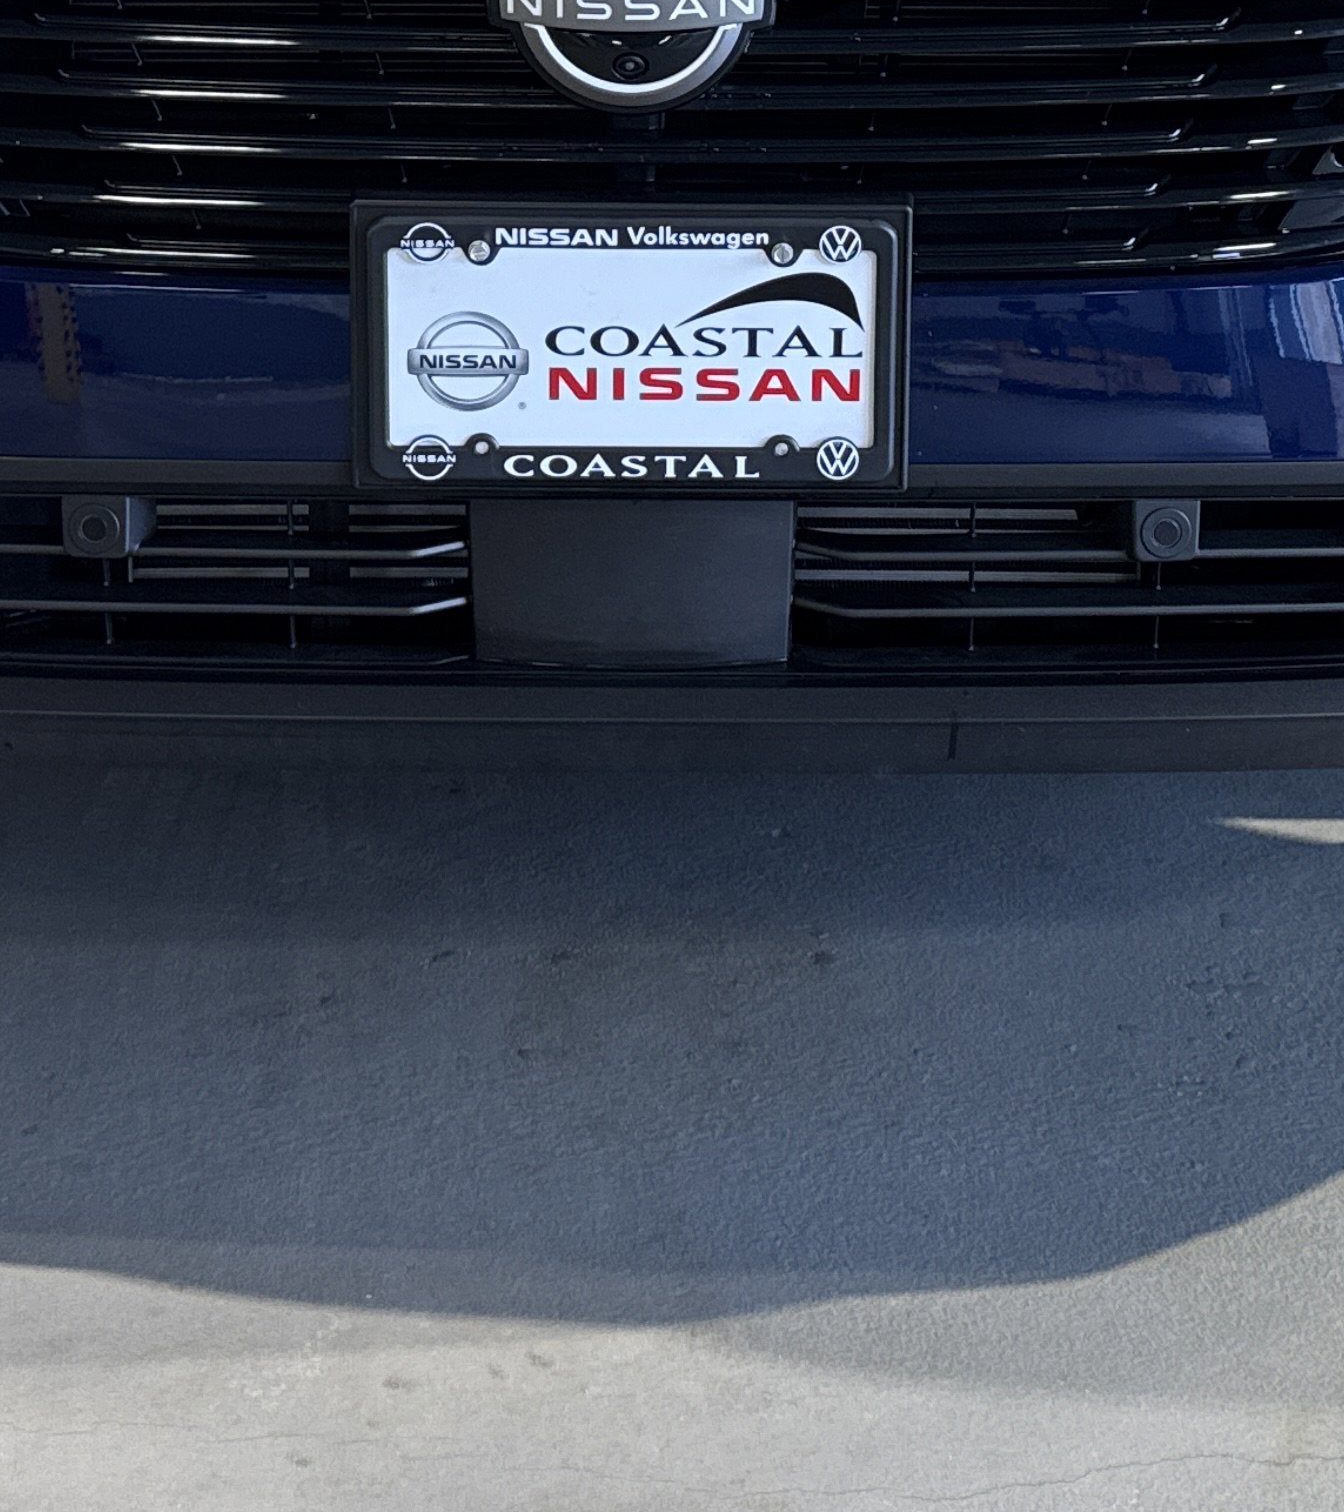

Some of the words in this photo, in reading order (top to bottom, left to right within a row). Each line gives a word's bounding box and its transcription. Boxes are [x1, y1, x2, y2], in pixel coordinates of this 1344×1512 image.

[400, 239, 455, 248] NISSAN
[495, 228, 619, 247] NISSAN
[627, 226, 769, 249] Volkswagen
[544, 325, 864, 358] COASTAL
[419, 354, 517, 369] NISSAN
[548, 367, 860, 402] NISSAN
[402, 454, 457, 463] NISSAN
[503, 453, 760, 479] COASTAL
